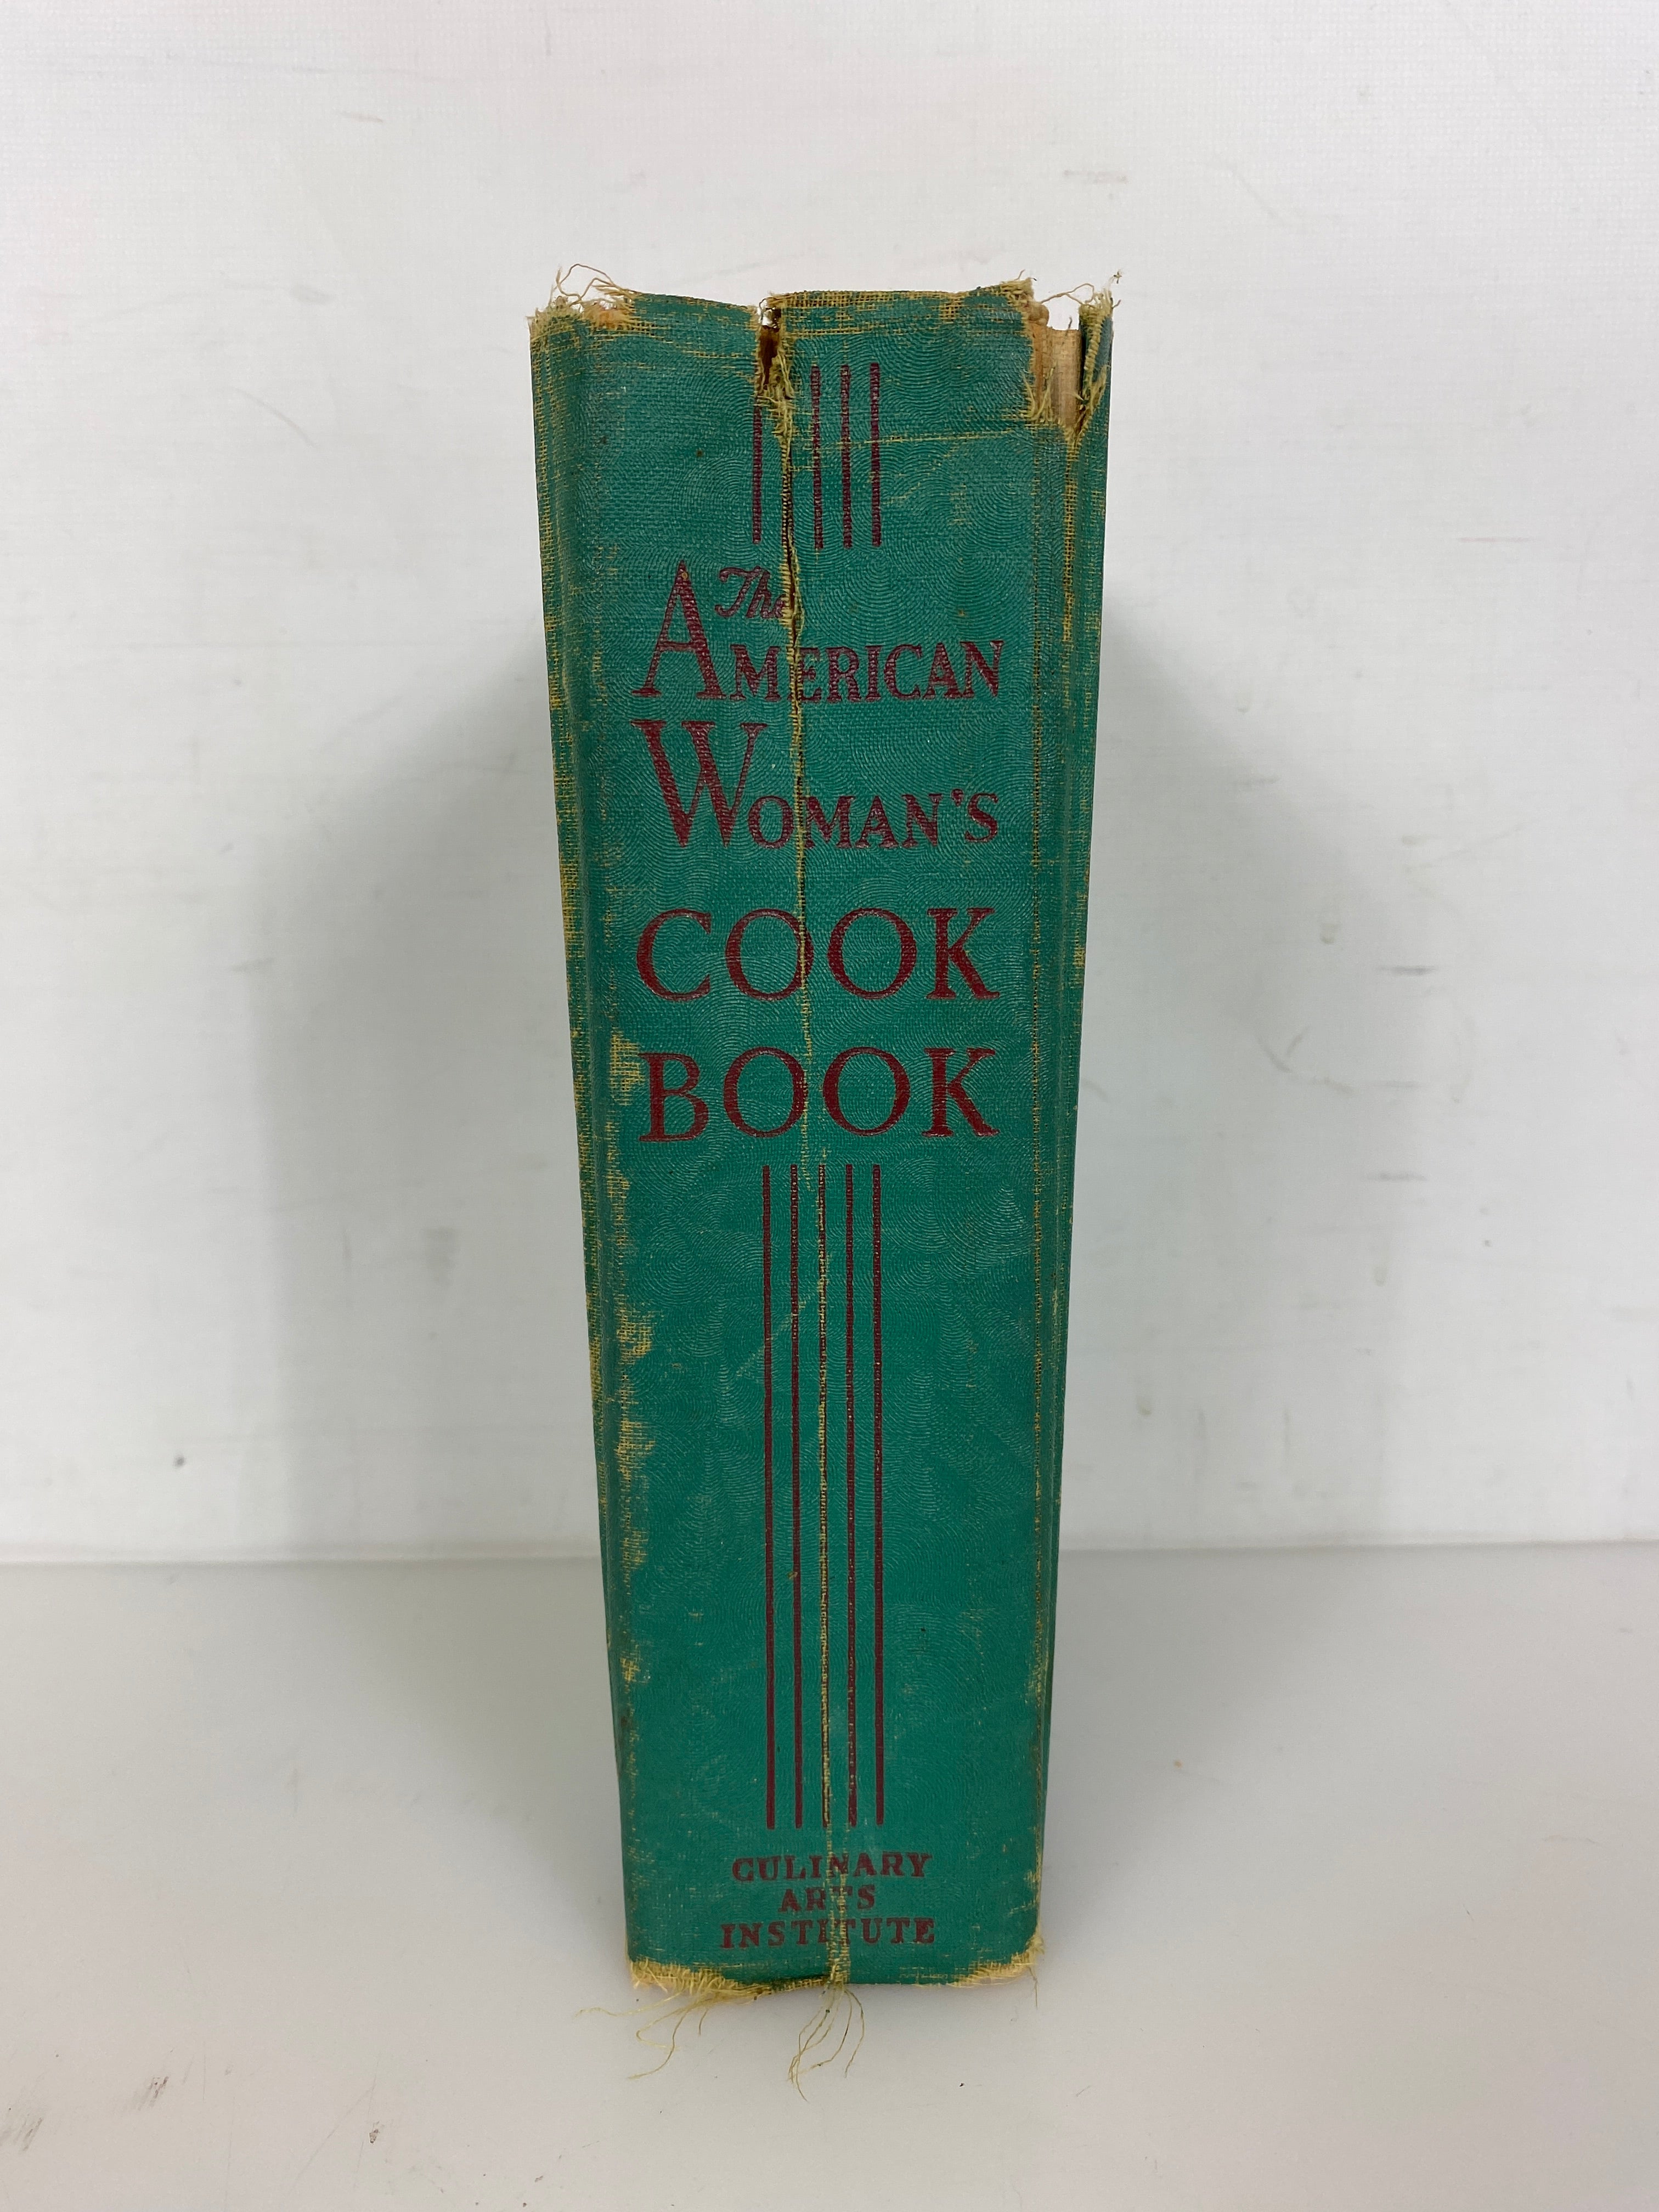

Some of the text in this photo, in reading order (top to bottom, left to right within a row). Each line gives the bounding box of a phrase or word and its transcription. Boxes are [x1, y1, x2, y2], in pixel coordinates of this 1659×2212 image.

[631, 560, 1005, 703] AMERICAN
[630, 719, 1000, 850] WOMAN'S
[636, 907, 1000, 1002] COOK
[637, 1046, 1000, 1142] BOOK
[732, 1850, 932, 1882] CULINARY
[778, 1884, 876, 1912] ARTS
[720, 1917, 935, 1949] INSTITUTE
